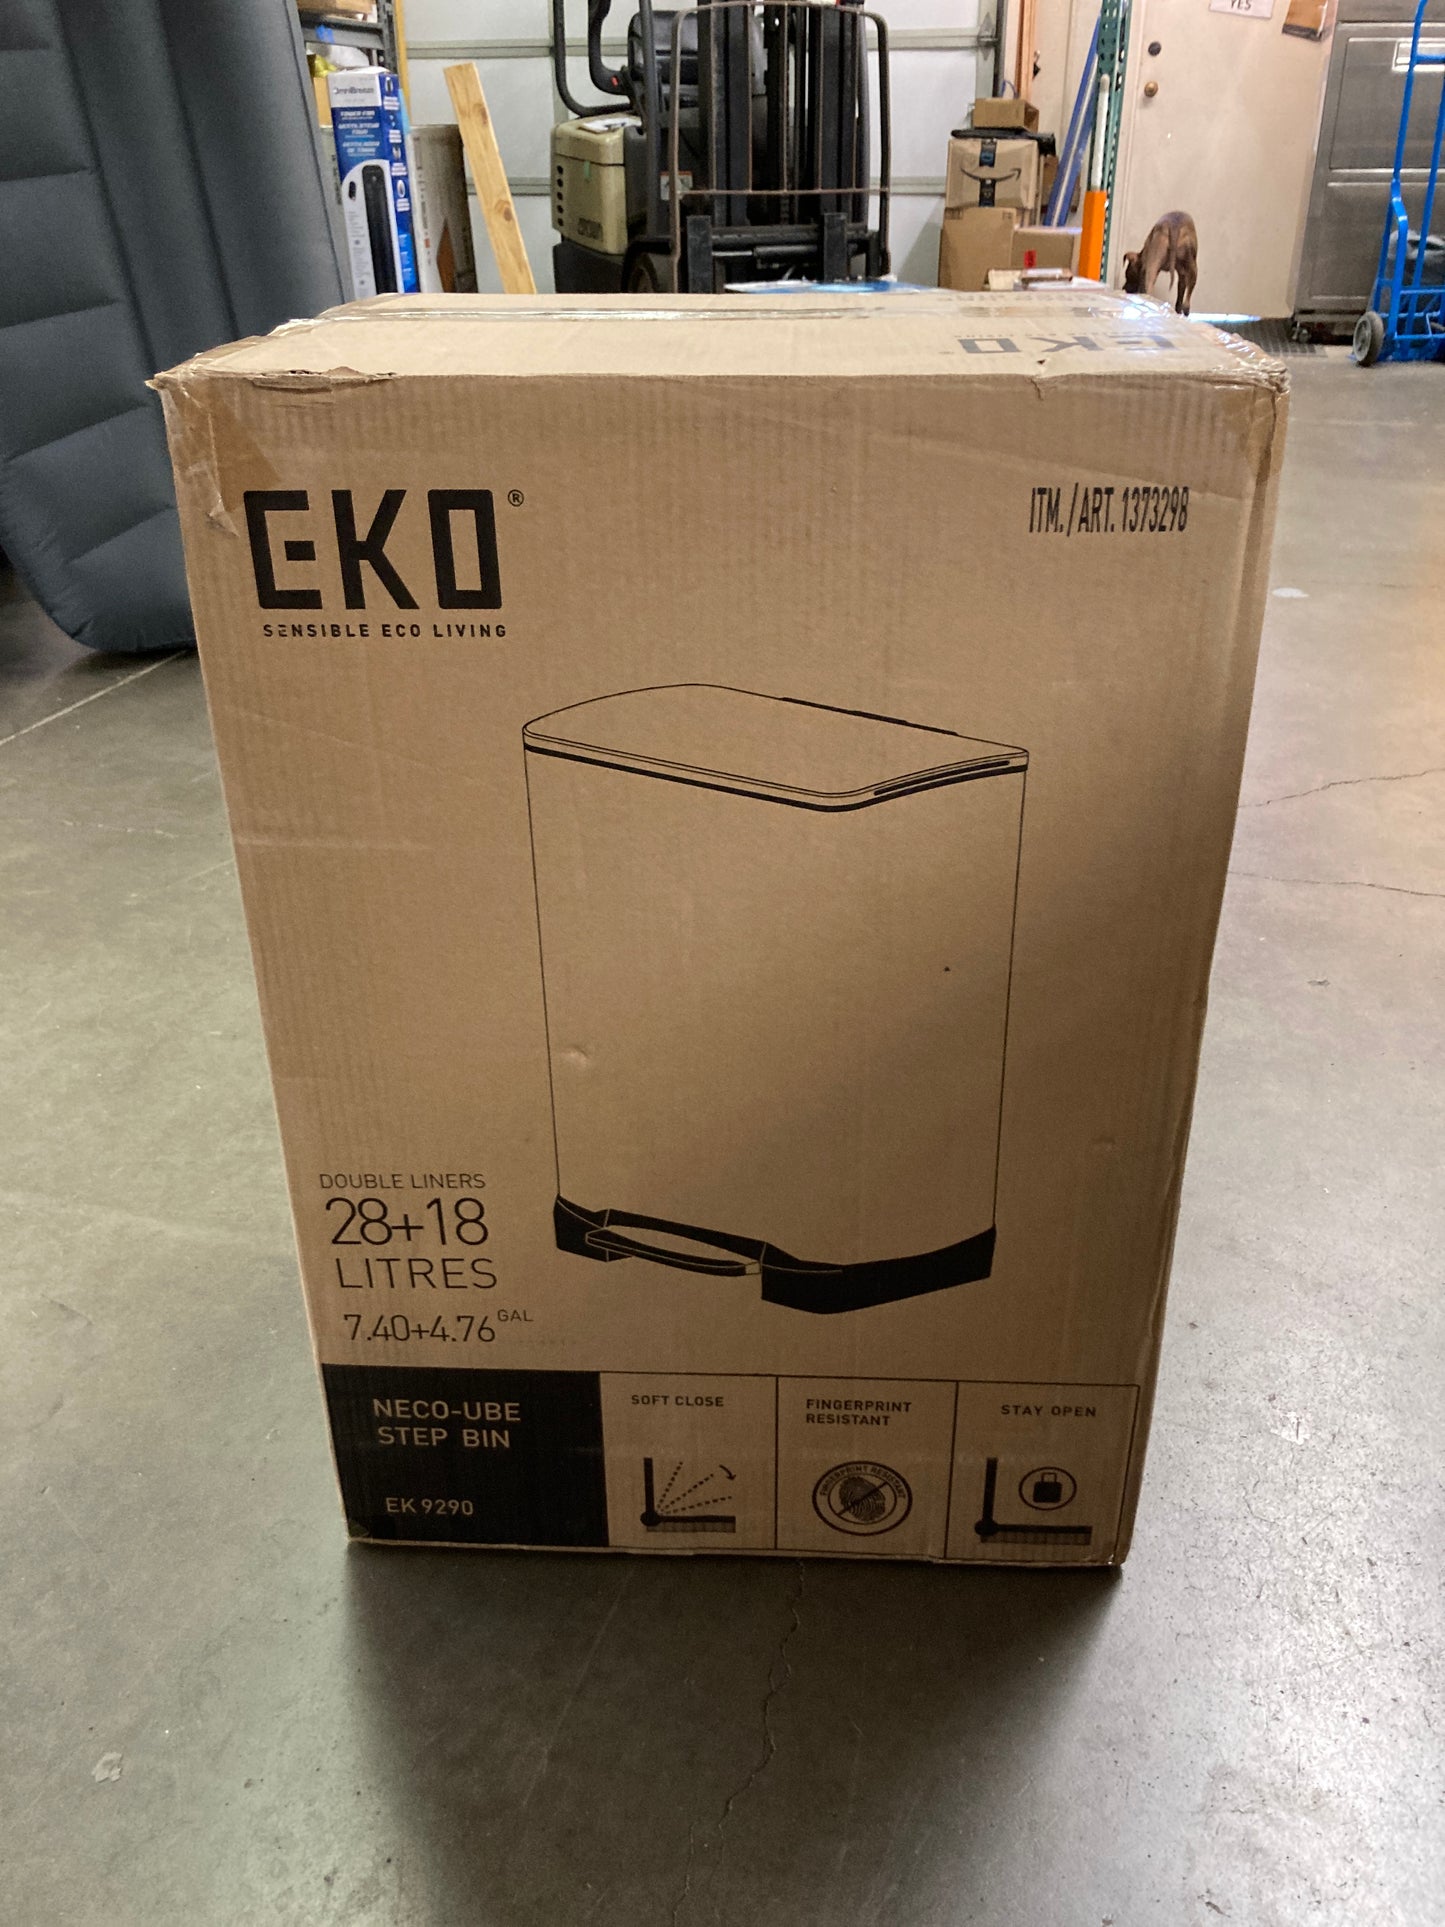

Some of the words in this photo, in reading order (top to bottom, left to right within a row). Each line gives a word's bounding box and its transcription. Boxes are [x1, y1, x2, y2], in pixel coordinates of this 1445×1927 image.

[1122, 486, 1189, 532] 1373298
[263, 624, 370, 638] SENSIBLE
[381, 624, 421, 638] ECO
[433, 624, 507, 638] LIVING
[319, 1173, 404, 1189] DOUBLE
[410, 1174, 486, 1189] LINERS
[325, 1197, 489, 1246] 28+18
[336, 1258, 498, 1289] LITRES
[631, 1395, 670, 1406] SOFT
[675, 1396, 724, 1407] CLOSE
[806, 1399, 912, 1413] FINGERPRINT
[373, 1399, 521, 1422] NECO-UBE
[1001, 1404, 1043, 1417] STAY
[1051, 1406, 1097, 1418] OPEN
[806, 1413, 890, 1426] RESISTANT
[378, 1426, 448, 1446] STEP
[462, 1429, 510, 1448] BIN
[386, 1497, 416, 1515] EK
[421, 1499, 474, 1516] 9290
